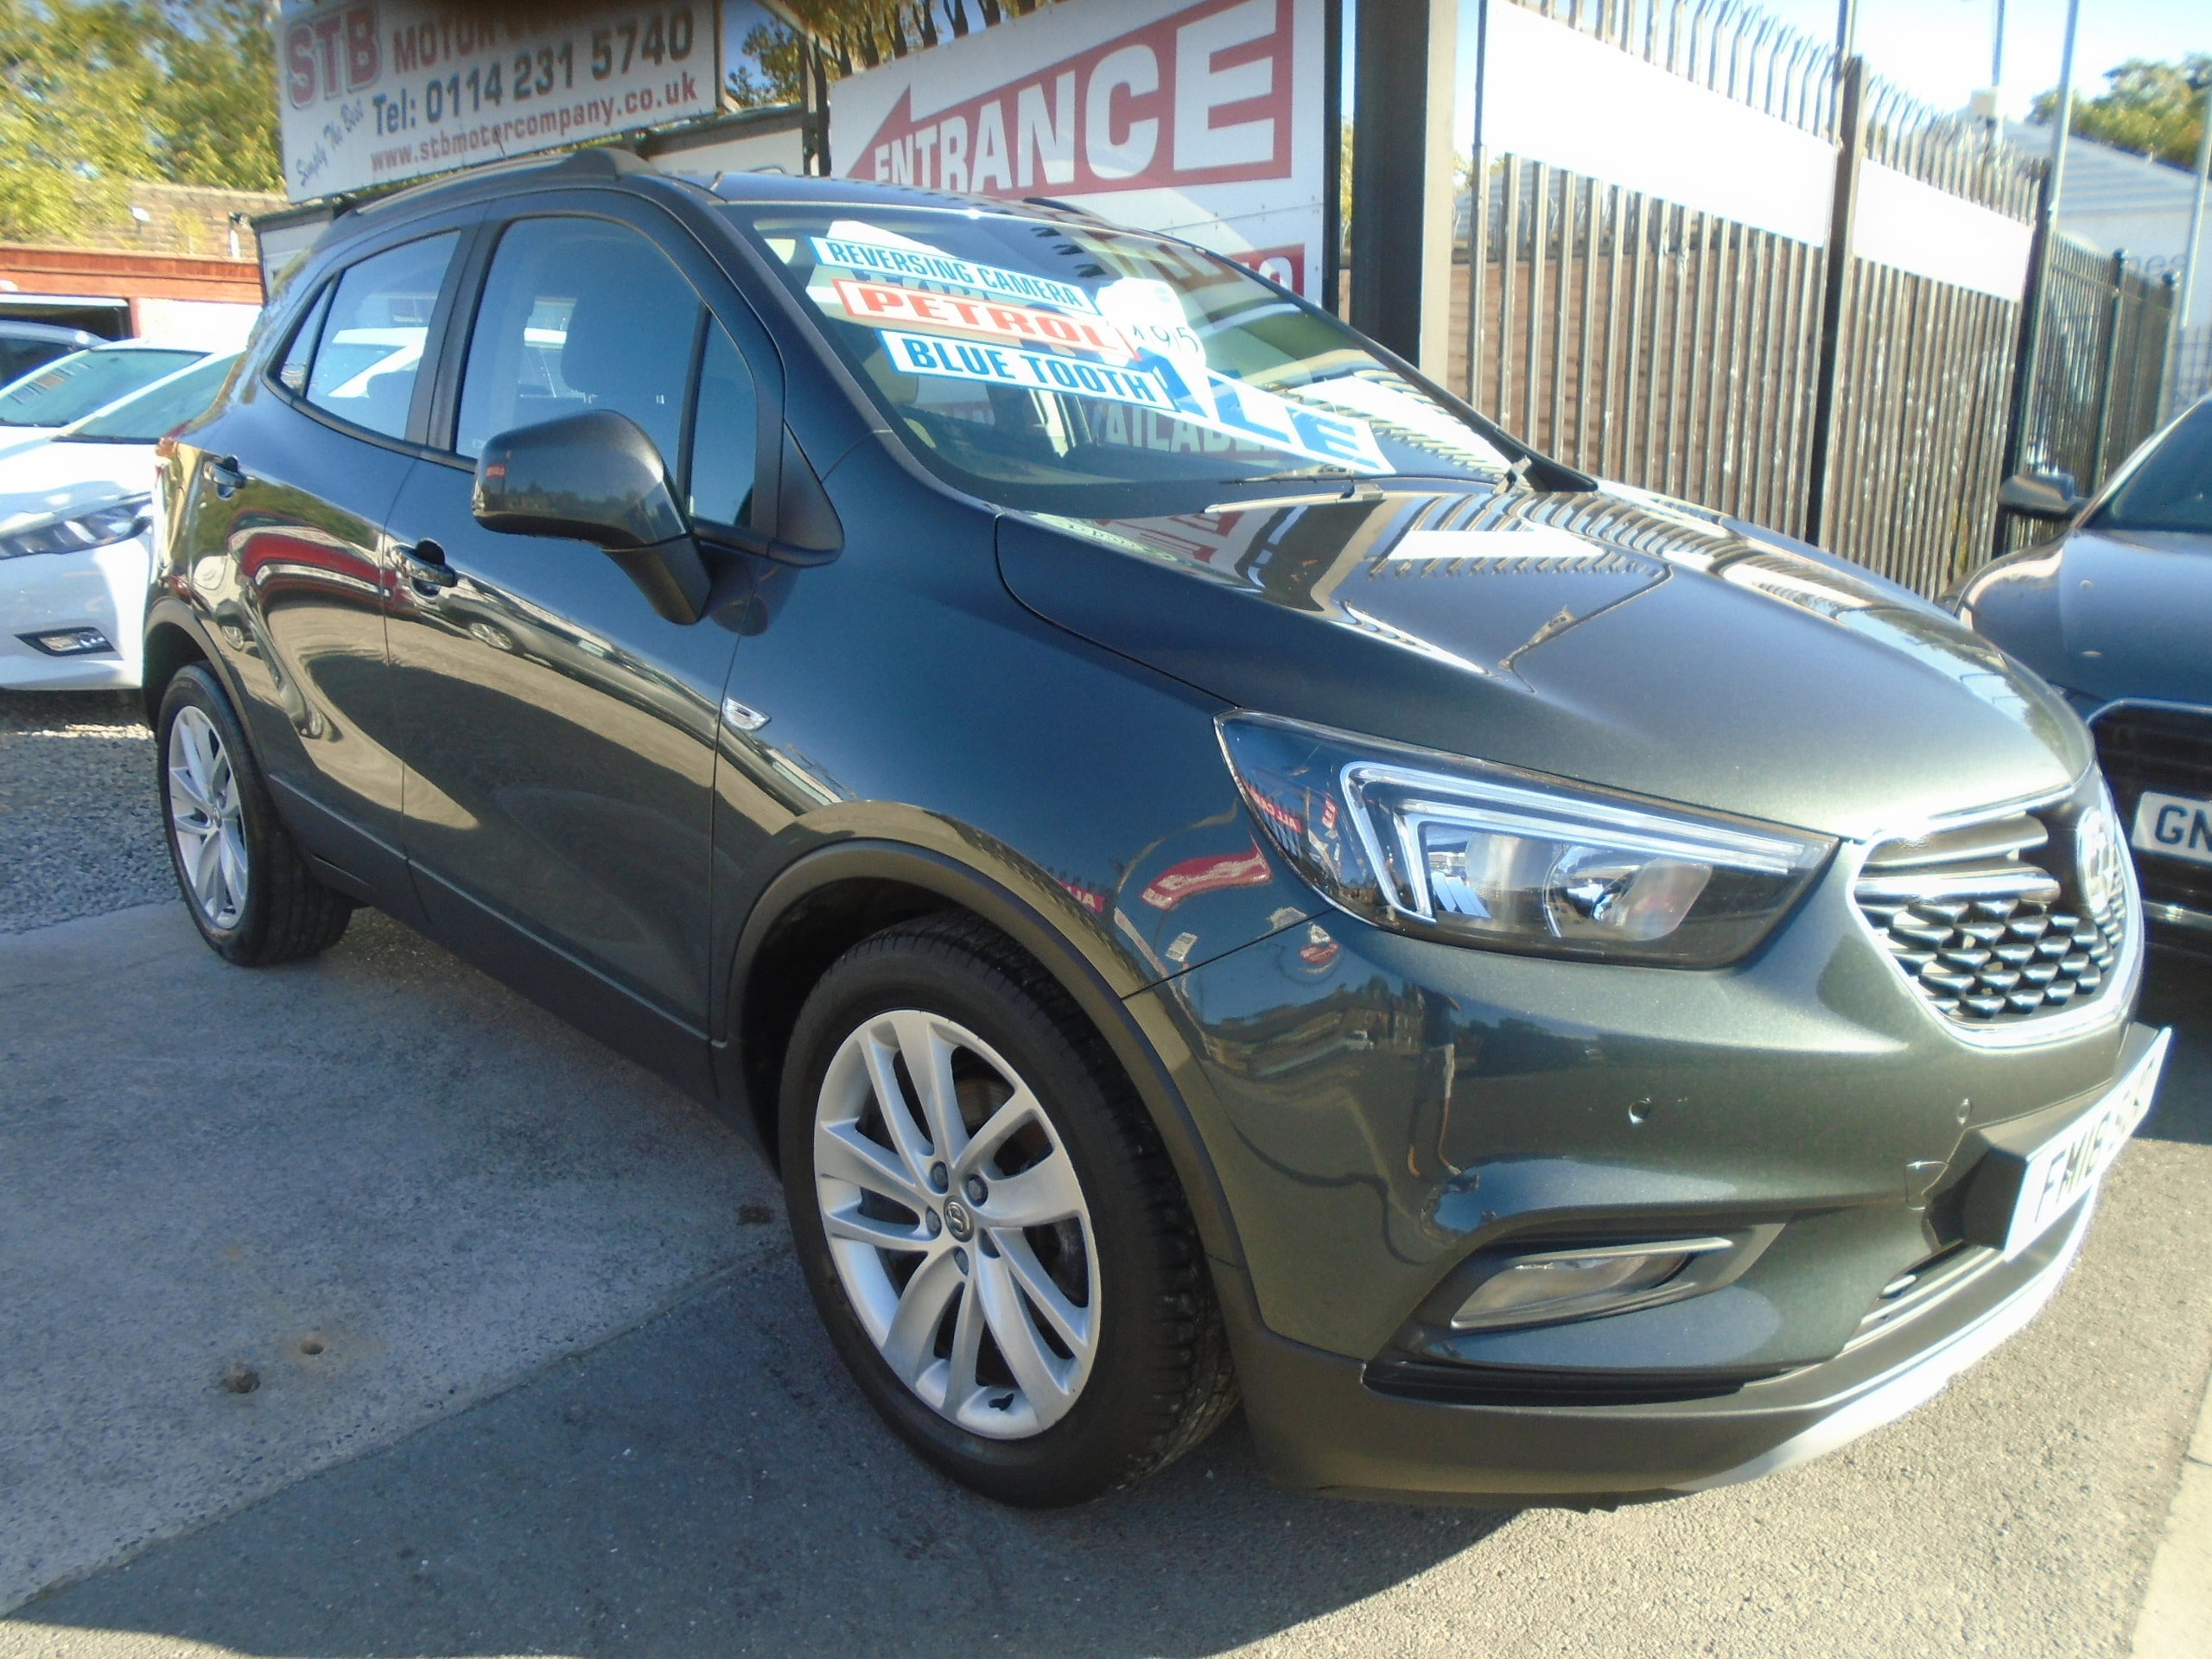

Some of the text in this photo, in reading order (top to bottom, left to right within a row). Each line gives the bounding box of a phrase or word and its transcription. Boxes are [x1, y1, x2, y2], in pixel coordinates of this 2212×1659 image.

[288, 8, 381, 109] STB
[372, 89, 416, 136] Tel:
[426, 60, 503, 124] 0114
[513, 42, 574, 102] 231
[591, 8, 695, 81] 5740
[874, 0, 1277, 194] ENTRANCE
[370, 71, 698, 171] www.stbmotorcompany.co.uk
[826, 241, 975, 284] REVERSING
[976, 267, 1083, 307] CAMERA
[856, 287, 1118, 351] PETROL
[901, 338, 1157, 403] BLUE TOOTH
